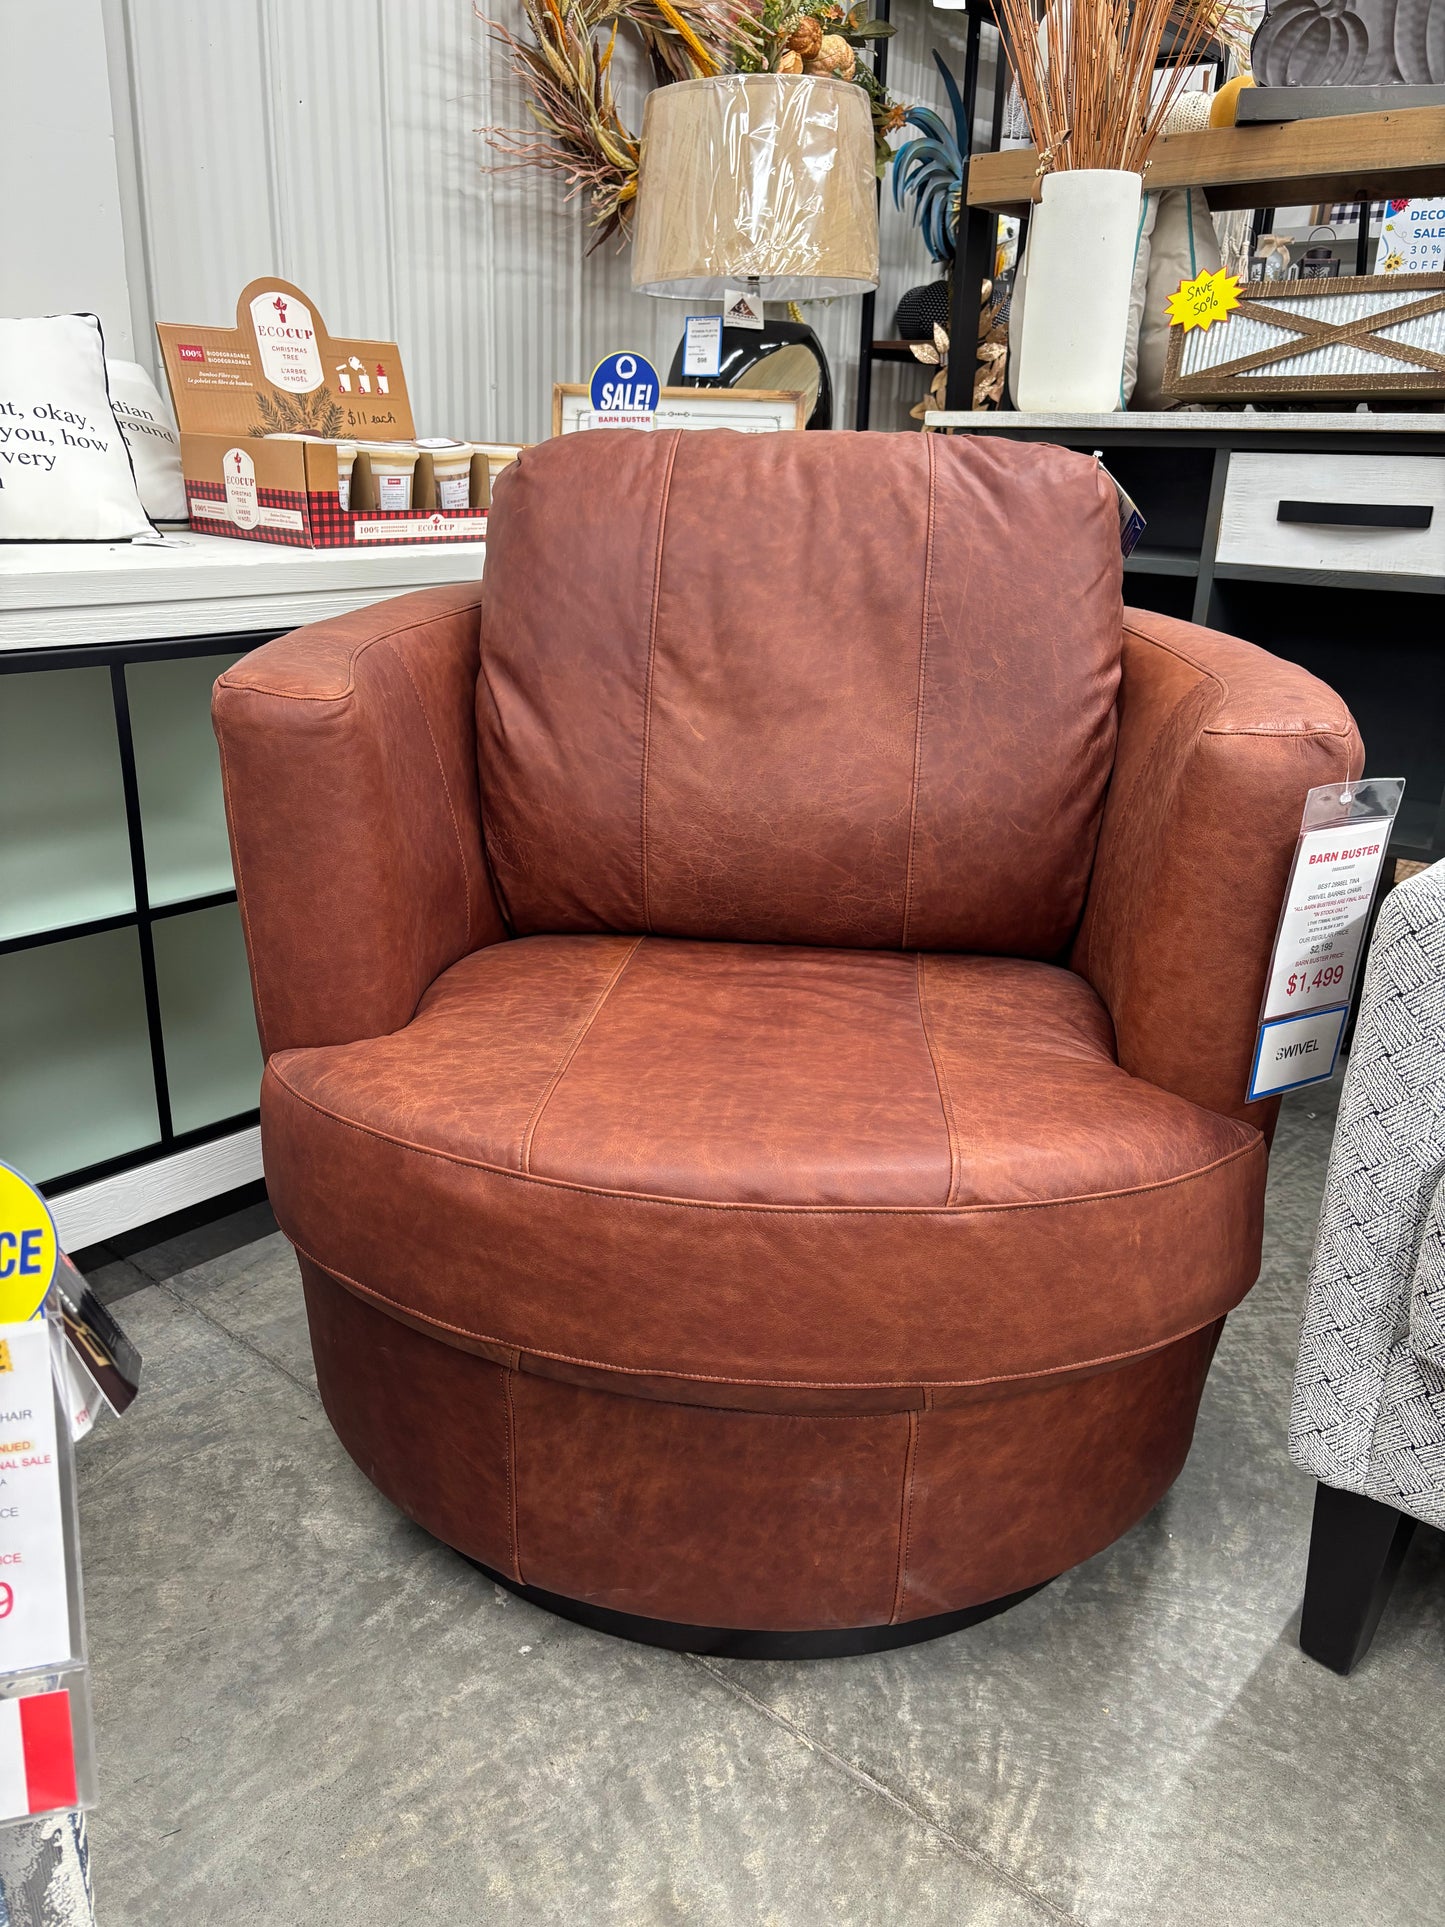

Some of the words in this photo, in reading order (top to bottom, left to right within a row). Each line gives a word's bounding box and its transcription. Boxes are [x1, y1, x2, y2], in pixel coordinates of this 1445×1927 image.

[1413, 227, 1445, 239] SALE
[1409, 260, 1438, 270] OFF
[1186, 279, 1214, 302] SAVE
[1193, 291, 1219, 316] 50%
[257, 325, 313, 340] ECOCUP
[180, 349, 203, 358] 100%
[271, 345, 308, 354] CHRISTMAS
[600, 382, 653, 411] SALE!
[33, 403, 96, 432] okay,
[347, 408, 367, 427] $11
[371, 411, 397, 424] each
[0, 426, 54, 447] you,
[60, 428, 109, 453] how
[0, 451, 57, 472] very
[226, 475, 255, 487] ECOCUP
[1308, 851, 1340, 865] BARN
[1341, 844, 1380, 860] BUSTER
[1347, 886, 1361, 894] CHAIR
[1310, 931, 1333, 941] REGULAR
[1309, 942, 1333, 954] $2,199
[1309, 954, 1329, 964] BUSTER
[1329, 951, 1344, 960] PRICE
[1286, 965, 1344, 997] $1,499
[1275, 1039, 1320, 1061] SWIVEL
[21, 1454, 52, 1467] SALE
